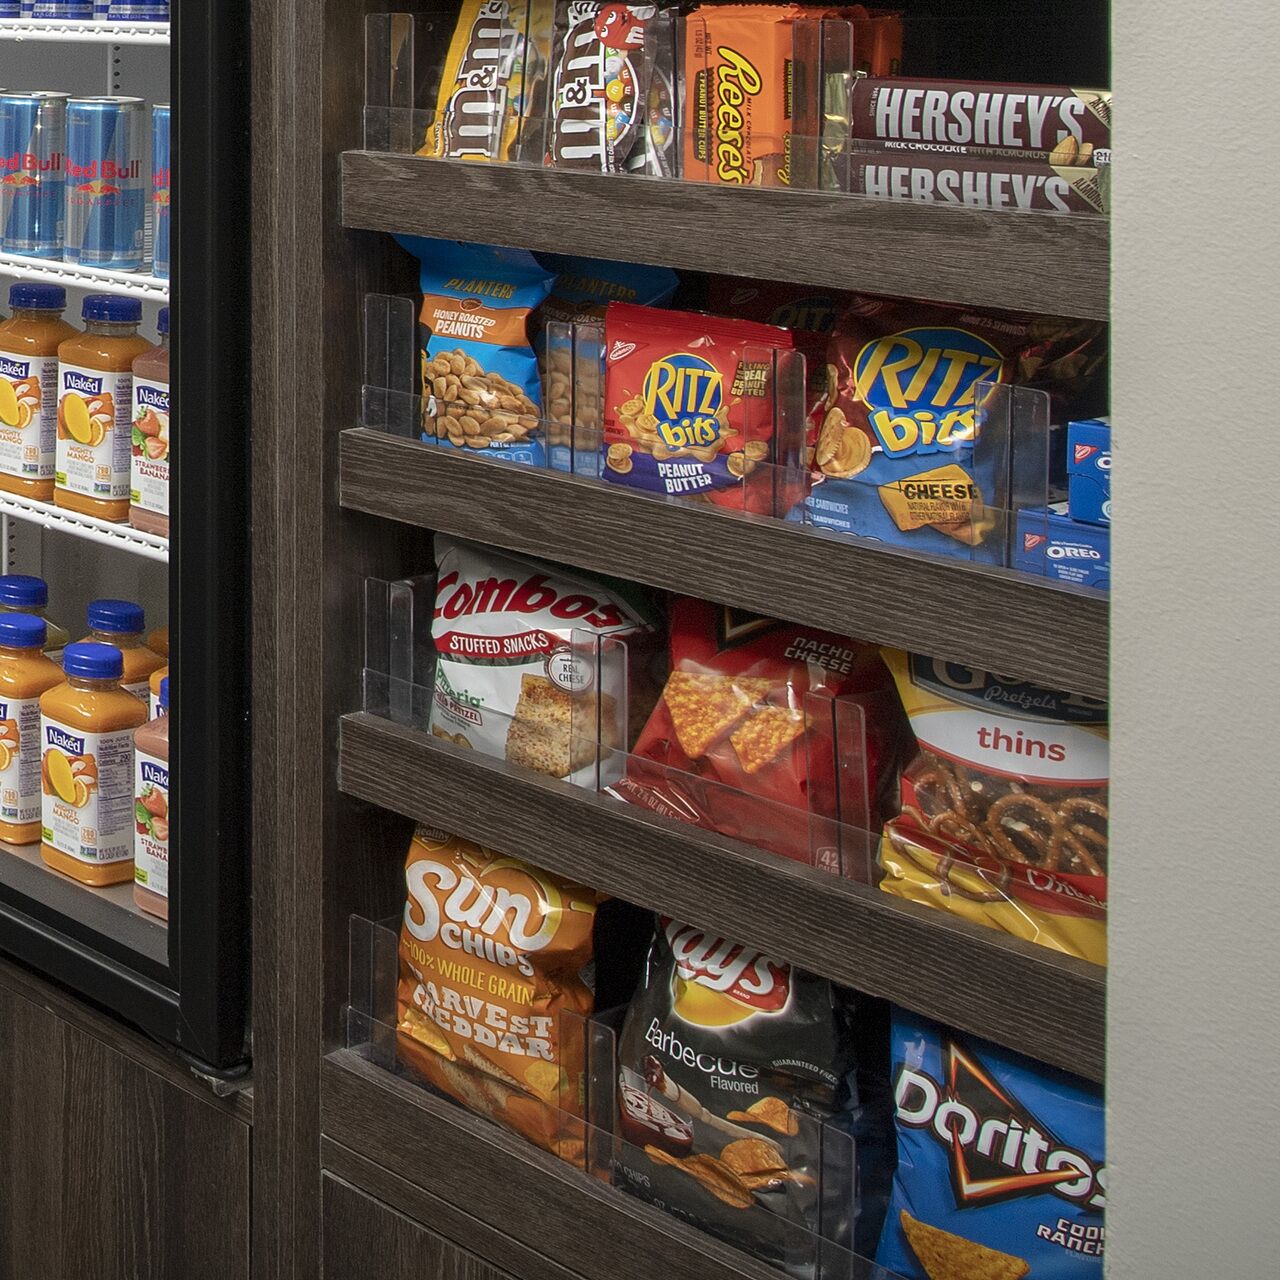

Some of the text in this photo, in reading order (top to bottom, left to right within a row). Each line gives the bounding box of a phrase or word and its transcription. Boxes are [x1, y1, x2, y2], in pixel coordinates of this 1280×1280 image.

[875, 88, 1086, 149] HERSHEY'S
[102, 160, 140, 178] Bull
[865, 165, 1070, 213] HERSHEY'S
[443, 277, 517, 300] PLANTERS
[433, 309, 496, 328] HONEY ROASTED
[434, 320, 483, 339] PEANUTS
[66, 375, 101, 393] Naked
[853, 335, 1003, 408] RITZ
[646, 361, 722, 420] RITZ
[659, 418, 719, 447] bits
[872, 408, 981, 452] bits
[658, 462, 704, 478] PEANUT
[665, 475, 712, 493] BUTTER
[904, 483, 978, 500] CHEESE
[1046, 547, 1100, 560] OREO
[435, 571, 626, 628] Combos
[449, 632, 549, 654] STUFFED SNACKS
[794, 637, 856, 662] NACHO
[562, 664, 580, 675] REAL
[784, 646, 852, 674] CHEESE
[558, 672, 585, 685] CHEESE
[985, 685, 1057, 711] Pretzels
[977, 728, 1066, 762] thins
[405, 860, 555, 951] Sun
[440, 927, 534, 976] CHIPS
[439, 958, 534, 1007] WHOLE GRAIN
[645, 1017, 759, 1079] Barbecue
[772, 1060, 819, 1075] GUARANTEED
[711, 1074, 760, 1096] Flavored
